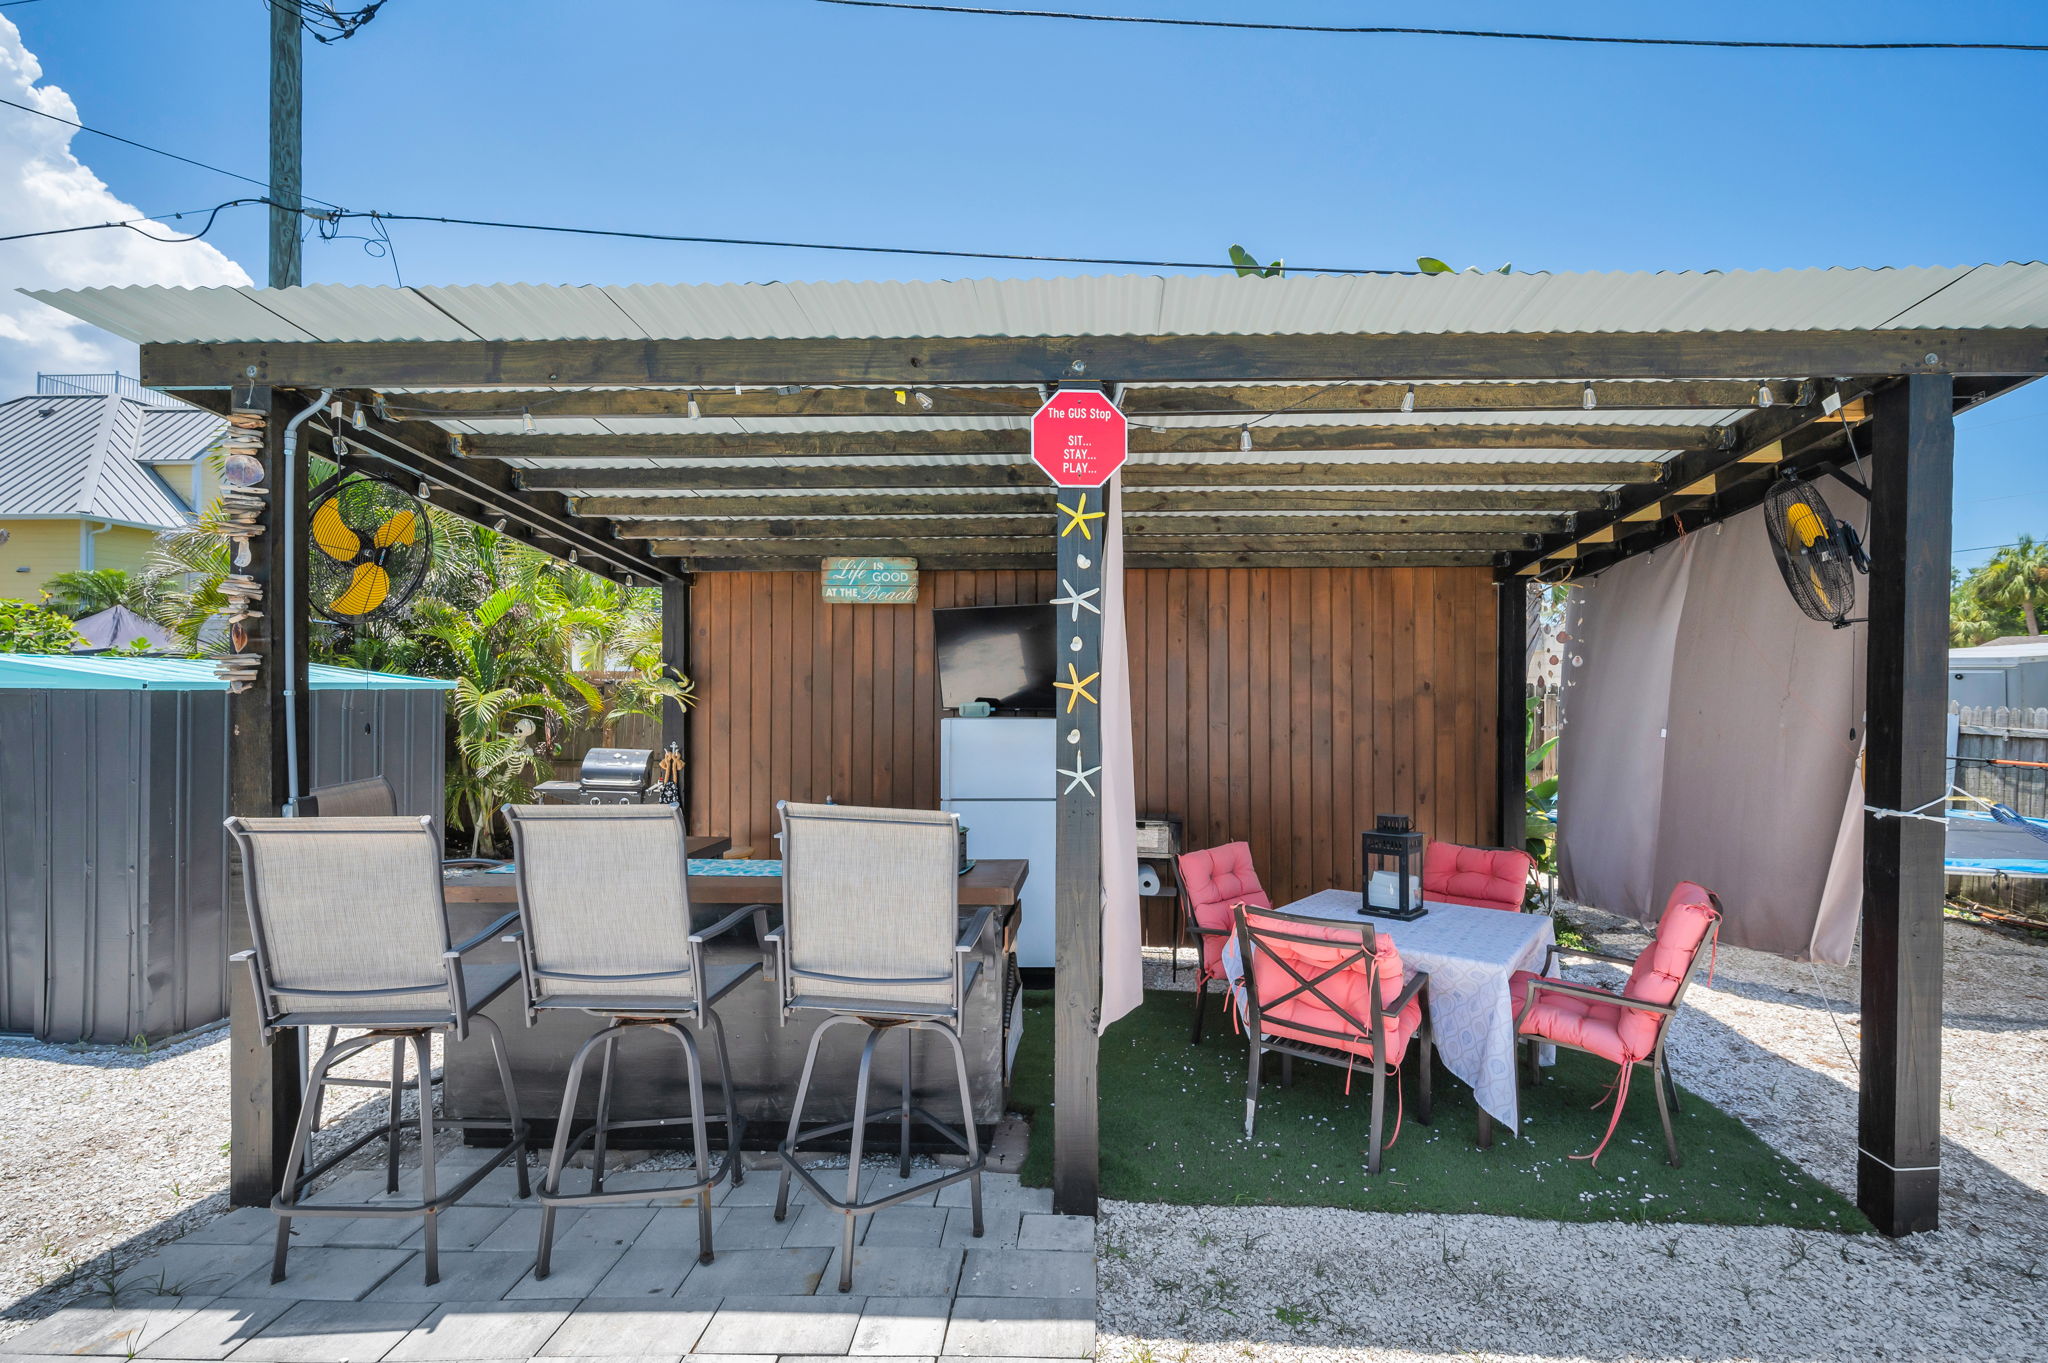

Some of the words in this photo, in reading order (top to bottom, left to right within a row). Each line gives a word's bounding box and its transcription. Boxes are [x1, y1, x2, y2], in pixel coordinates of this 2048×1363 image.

[1048, 407, 1065, 418] The
[1068, 407, 1087, 419] GUS
[1090, 408, 1111, 421] Stop
[1068, 435, 1092, 446] SIT...
[1063, 448, 1097, 460] STAY...
[1063, 462, 1097, 473] PLAY...
[832, 558, 867, 585] Life
[873, 562, 884, 570] IS
[872, 572, 909, 582] GOOD
[825, 588, 837, 597] AT
[839, 588, 858, 597] THE
[857, 582, 917, 601] Beach
